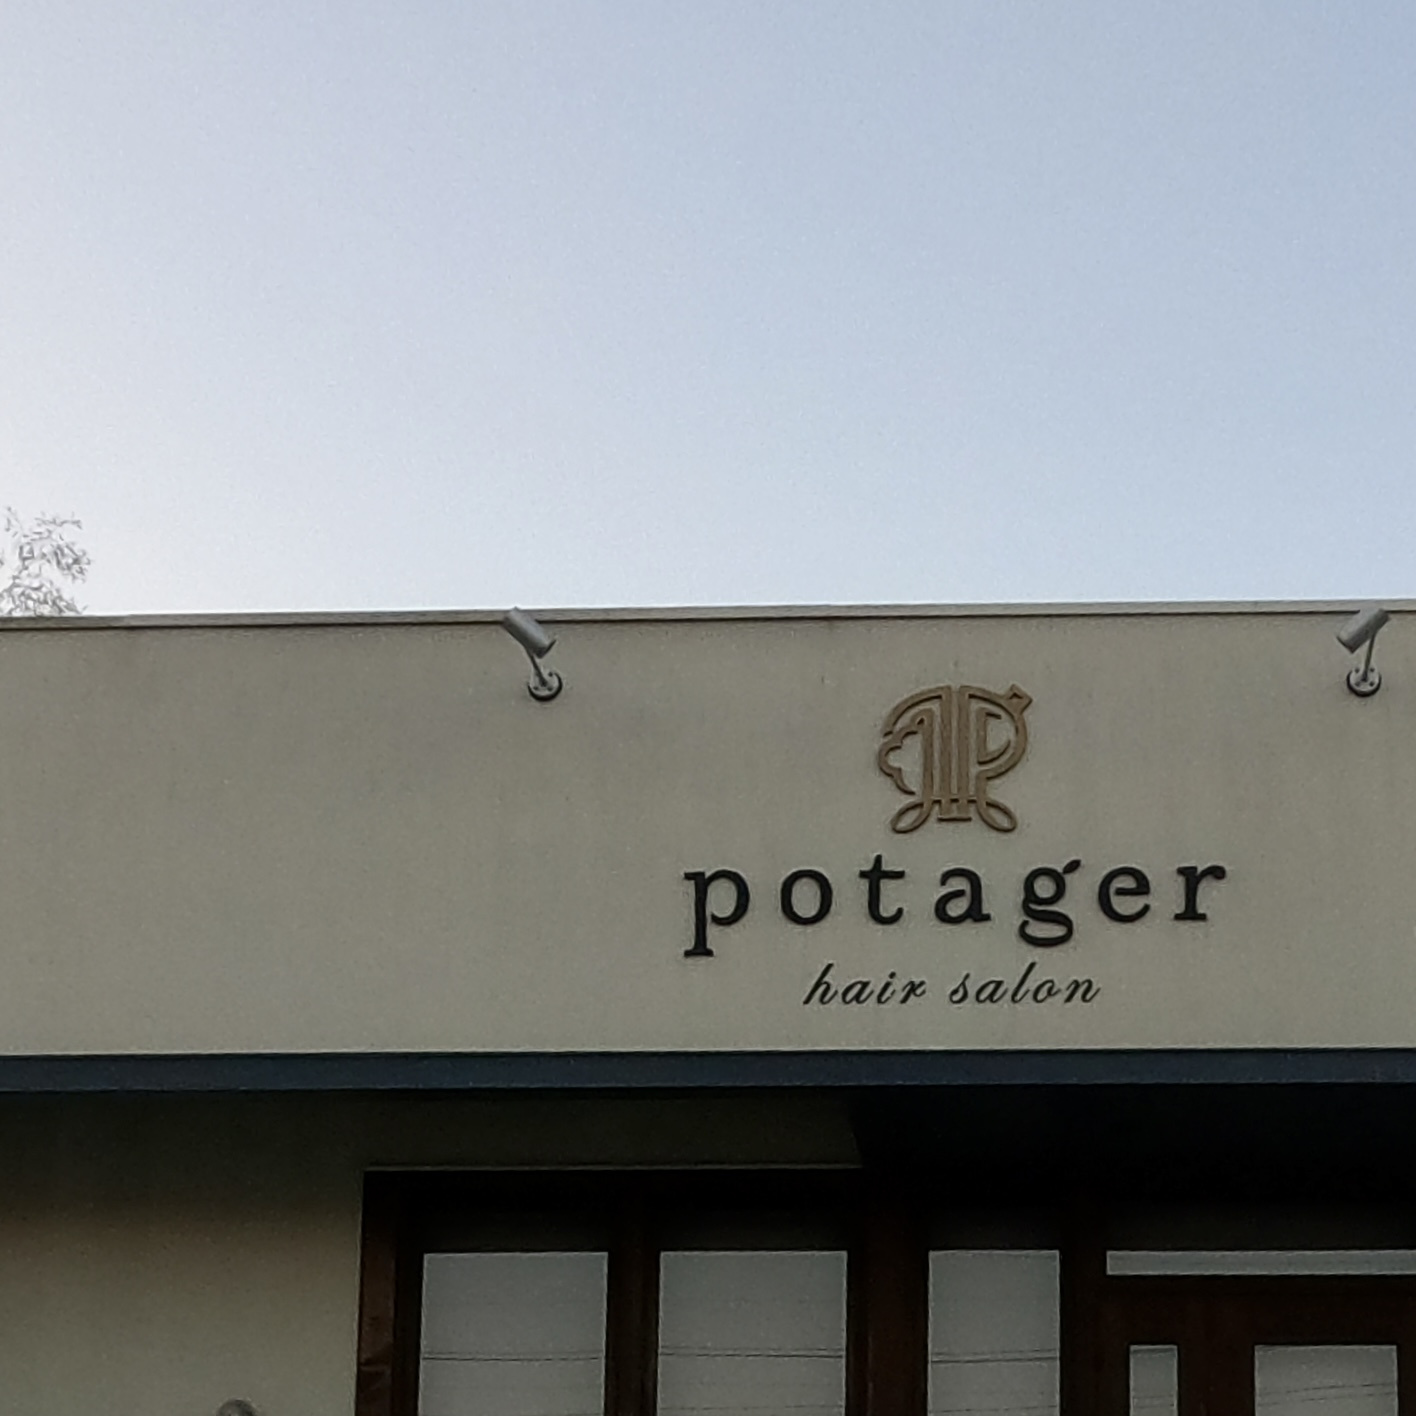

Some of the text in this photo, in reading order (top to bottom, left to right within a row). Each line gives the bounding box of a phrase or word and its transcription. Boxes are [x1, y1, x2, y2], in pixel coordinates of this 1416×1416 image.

[683, 854, 1227, 958] potager
[804, 962, 1101, 1006] hair salon
